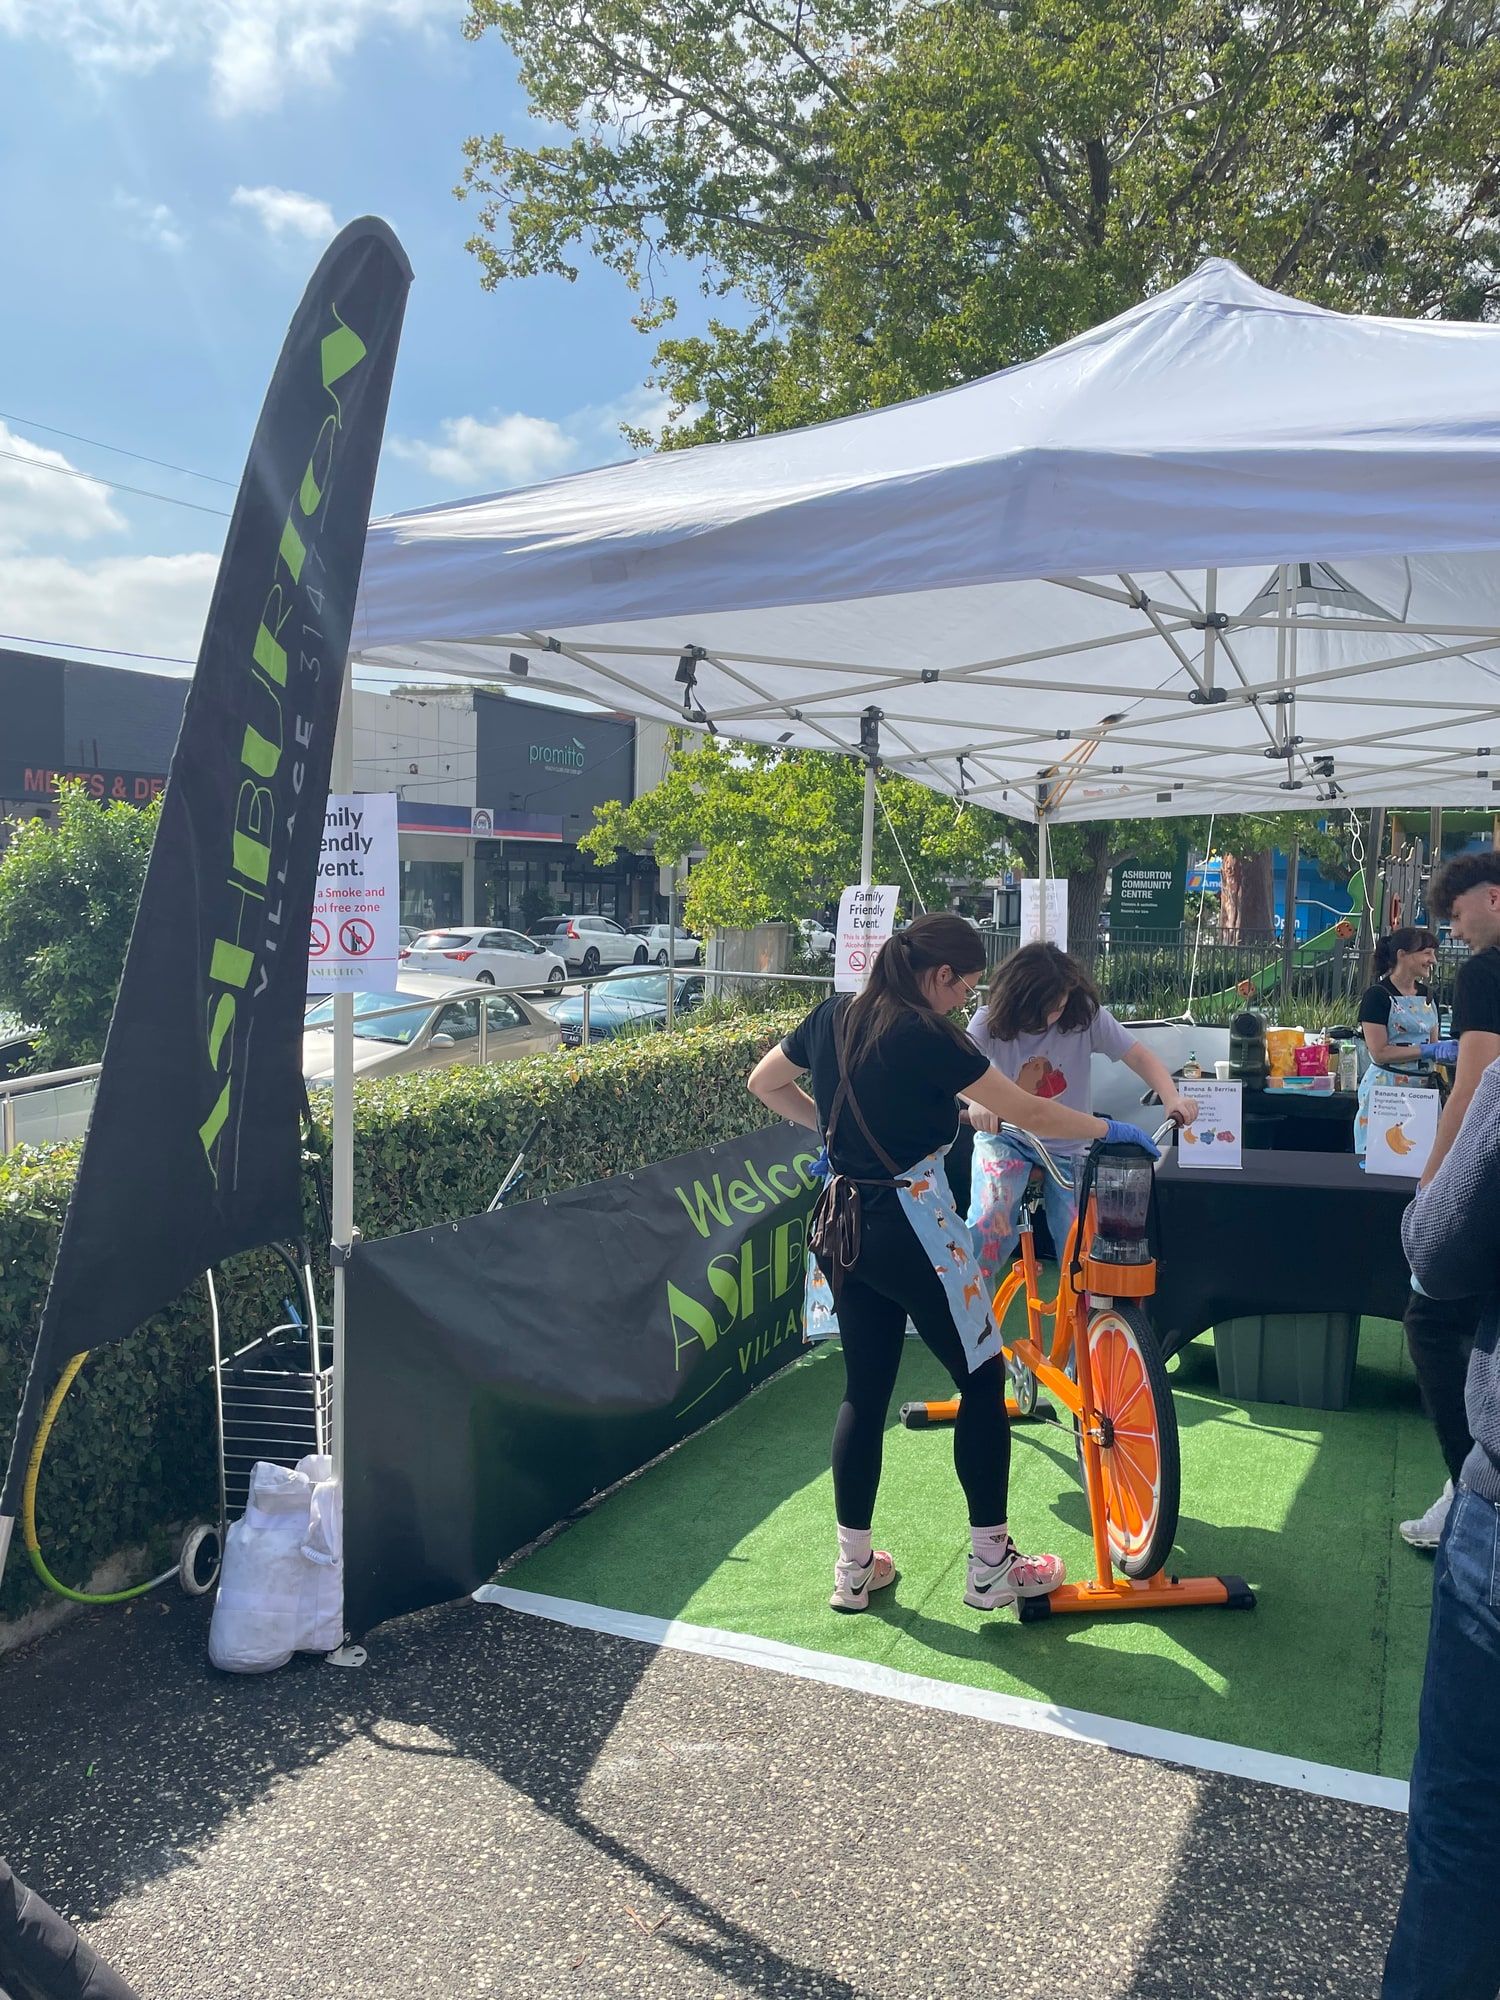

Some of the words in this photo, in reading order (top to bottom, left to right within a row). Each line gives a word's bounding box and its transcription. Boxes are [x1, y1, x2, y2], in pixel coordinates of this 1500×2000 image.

[300, 543, 329, 683] 3147
[198, 301, 367, 1191] ASHBURTON
[111, 776, 127, 798] &
[134, 777, 167, 800] DE
[325, 807, 364, 830] mily
[319, 832, 373, 854] endly
[317, 859, 364, 877] vent.
[1122, 870, 1172, 880] ASHBURTON
[1121, 880, 1172, 890] COMMUNITY
[318, 890, 323, 898] a
[326, 887, 362, 898] Smoke
[365, 887, 385, 897] and
[854, 891, 884, 903] Family
[1121, 890, 1153, 899] CENTRE
[330, 903, 351, 913] free
[354, 903, 380, 913] zone
[849, 904, 885, 917] Friendly
[853, 918, 880, 929] Event.
[1273, 914, 1300, 930] Opn
[1374, 1090, 1398, 1098] Banana
[1408, 1092, 1434, 1100] Coconut
[674, 1145, 826, 1238] Welco
[738, 1303, 805, 1374] VILLA
